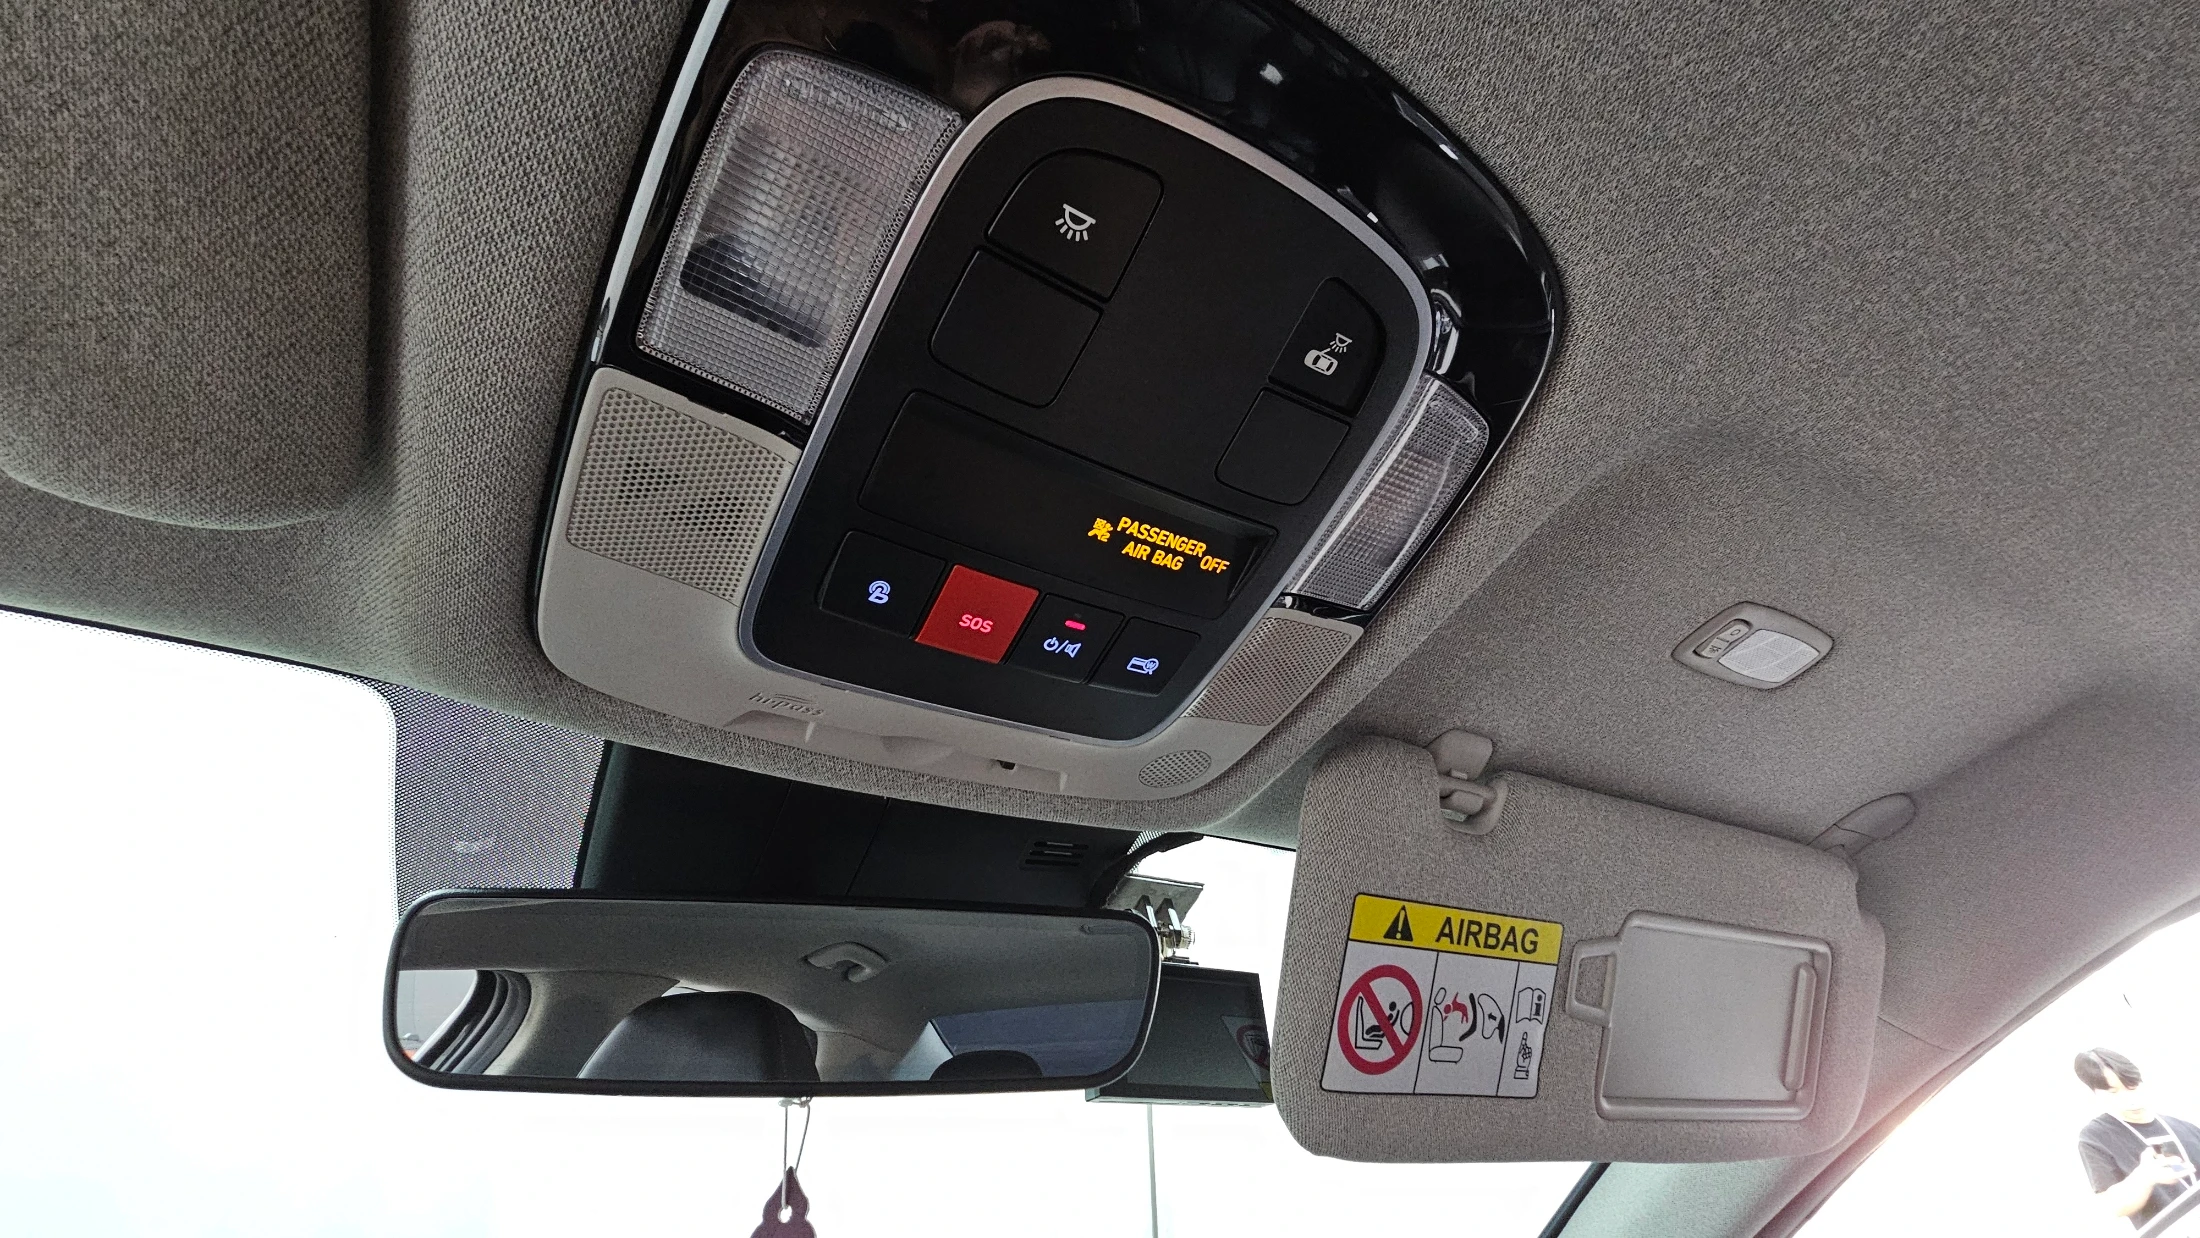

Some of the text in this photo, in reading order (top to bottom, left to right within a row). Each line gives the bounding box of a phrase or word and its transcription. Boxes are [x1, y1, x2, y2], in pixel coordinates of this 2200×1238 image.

[1117, 516, 1206, 557] PASSENGER
[1121, 541, 1184, 571] AIR BAG
[1200, 555, 1230, 573] OFF
[959, 614, 993, 633] SOS
[1435, 916, 1540, 955] AIRBAG
